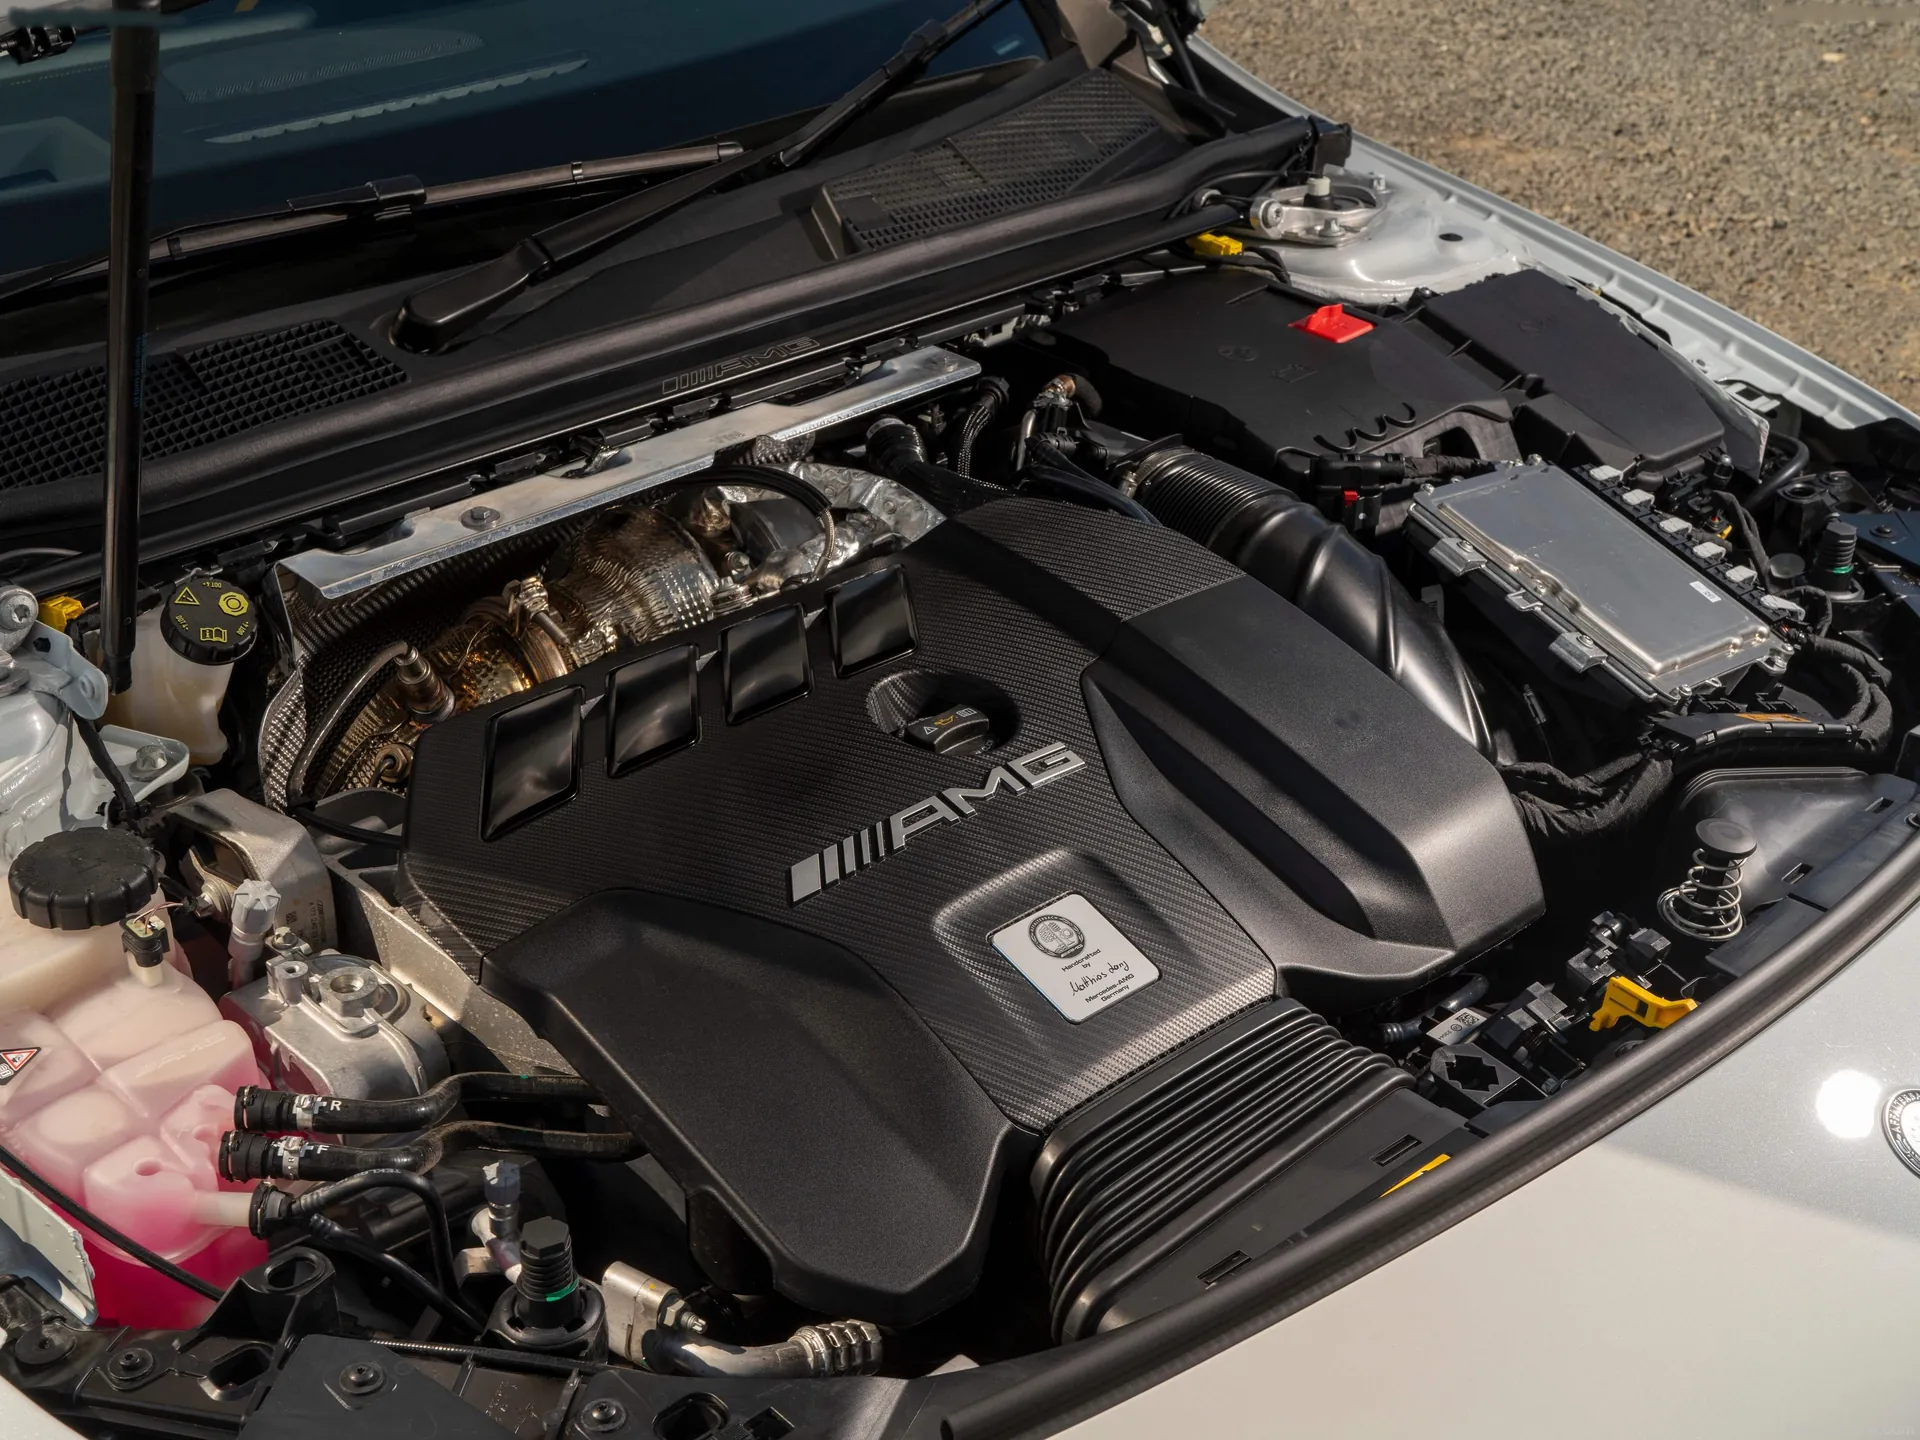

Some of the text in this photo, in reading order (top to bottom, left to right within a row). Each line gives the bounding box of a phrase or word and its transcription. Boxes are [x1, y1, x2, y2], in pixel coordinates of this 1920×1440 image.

[715, 336, 820, 378] AMG
[890, 741, 1086, 855] AMG
[1061, 949, 1101, 972] Handcrafted
[1085, 973, 1135, 1003] Mercedes-AMG
[1101, 985, 1130, 1002] Germany
